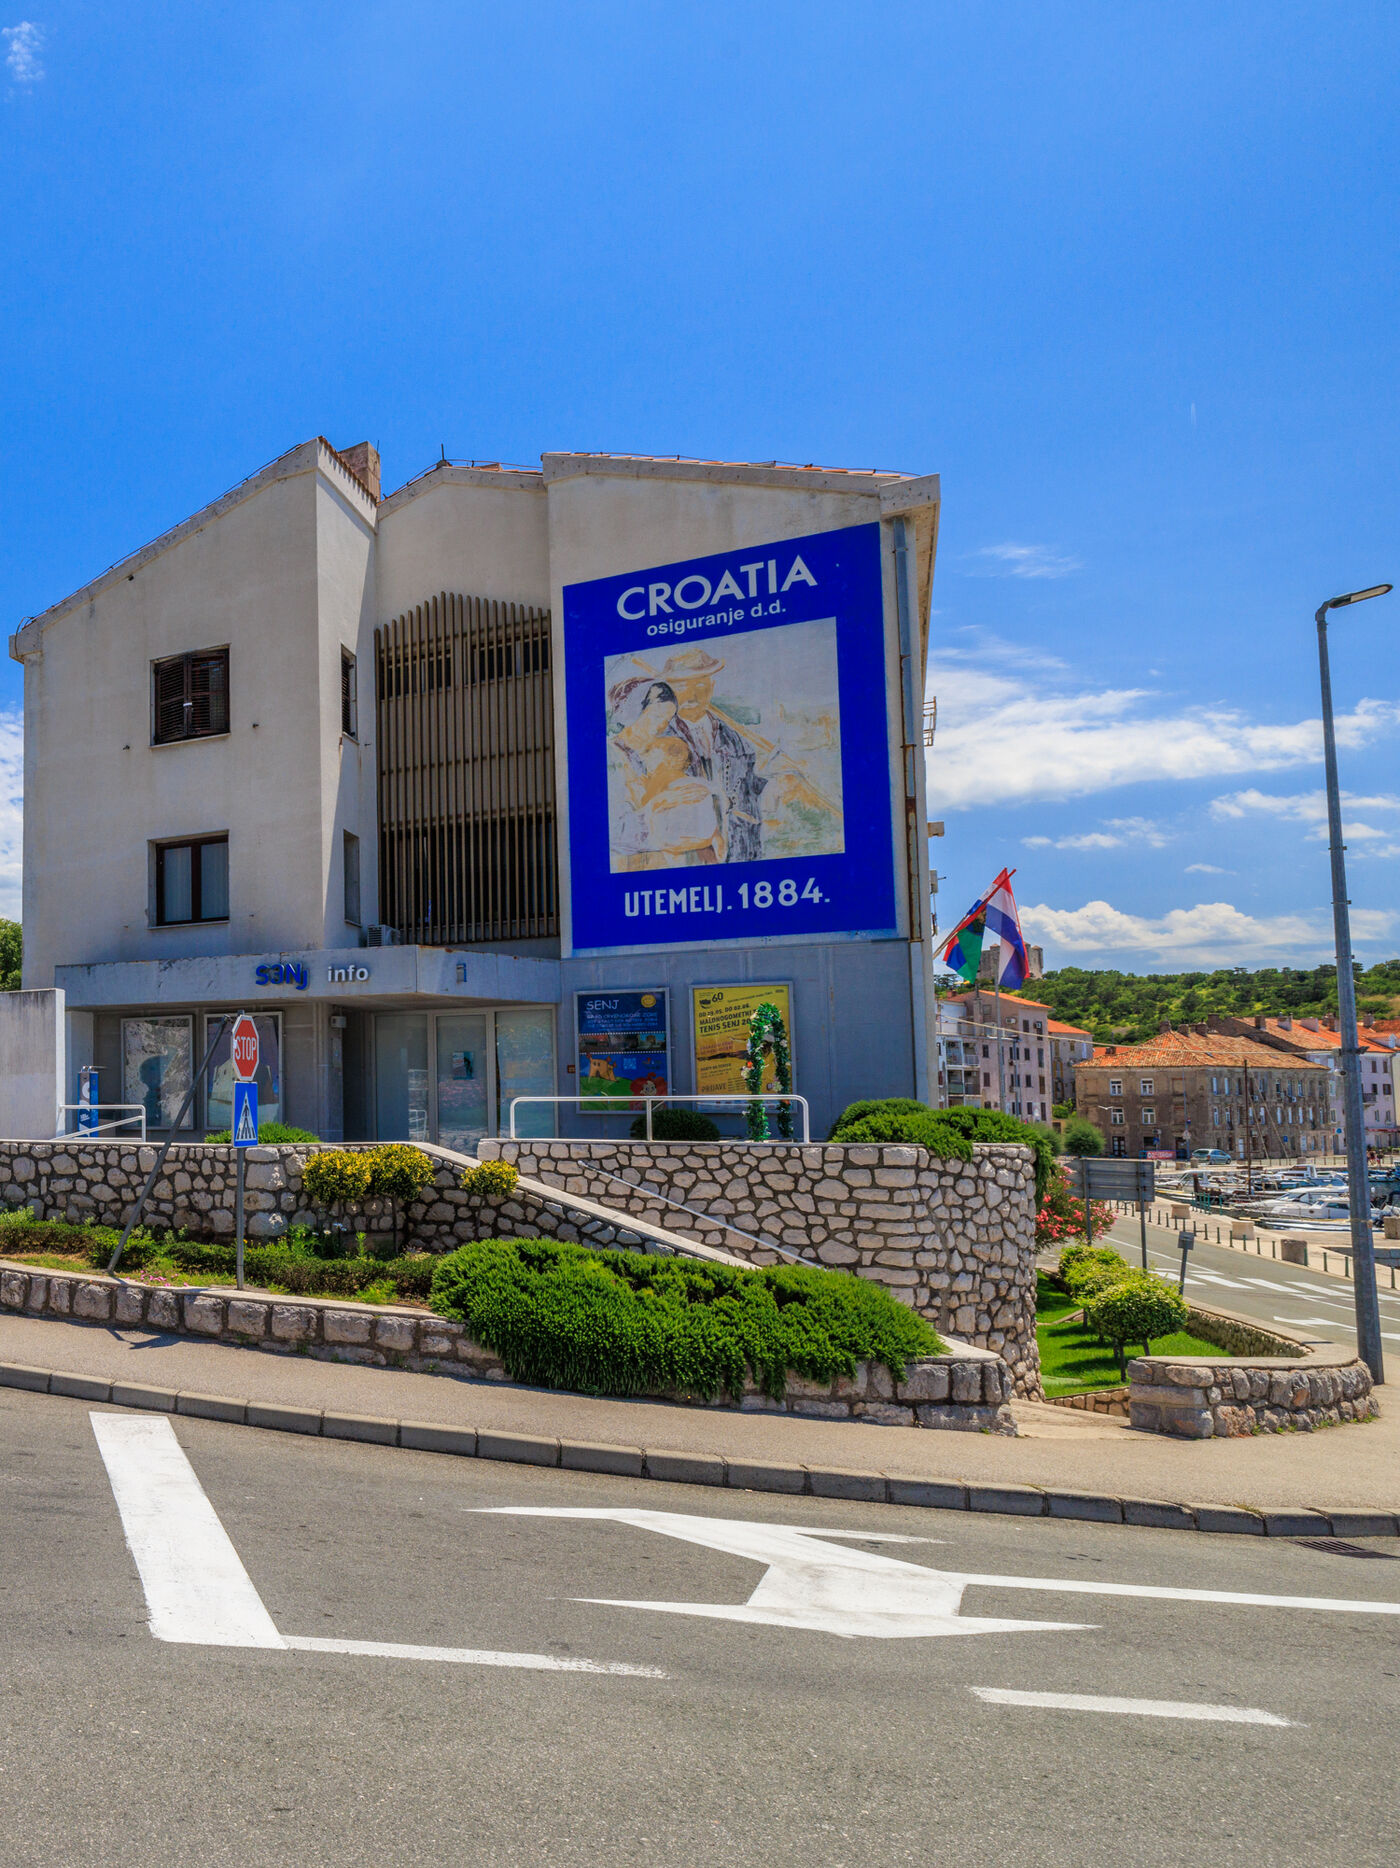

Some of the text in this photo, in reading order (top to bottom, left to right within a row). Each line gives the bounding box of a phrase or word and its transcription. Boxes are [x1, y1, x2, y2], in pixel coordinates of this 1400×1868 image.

[616, 555, 818, 620] CROATIA
[647, 600, 786, 636] osiguranje d.d.
[624, 877, 830, 917] UTEMELJ. 1884.
[327, 965, 369, 982] info
[586, 1000, 619, 1010] SENJ
[712, 992, 724, 1003] 60
[699, 1023, 720, 1033] TENIS
[722, 1019, 740, 1029] SENJ
[235, 1036, 257, 1060] STOP
